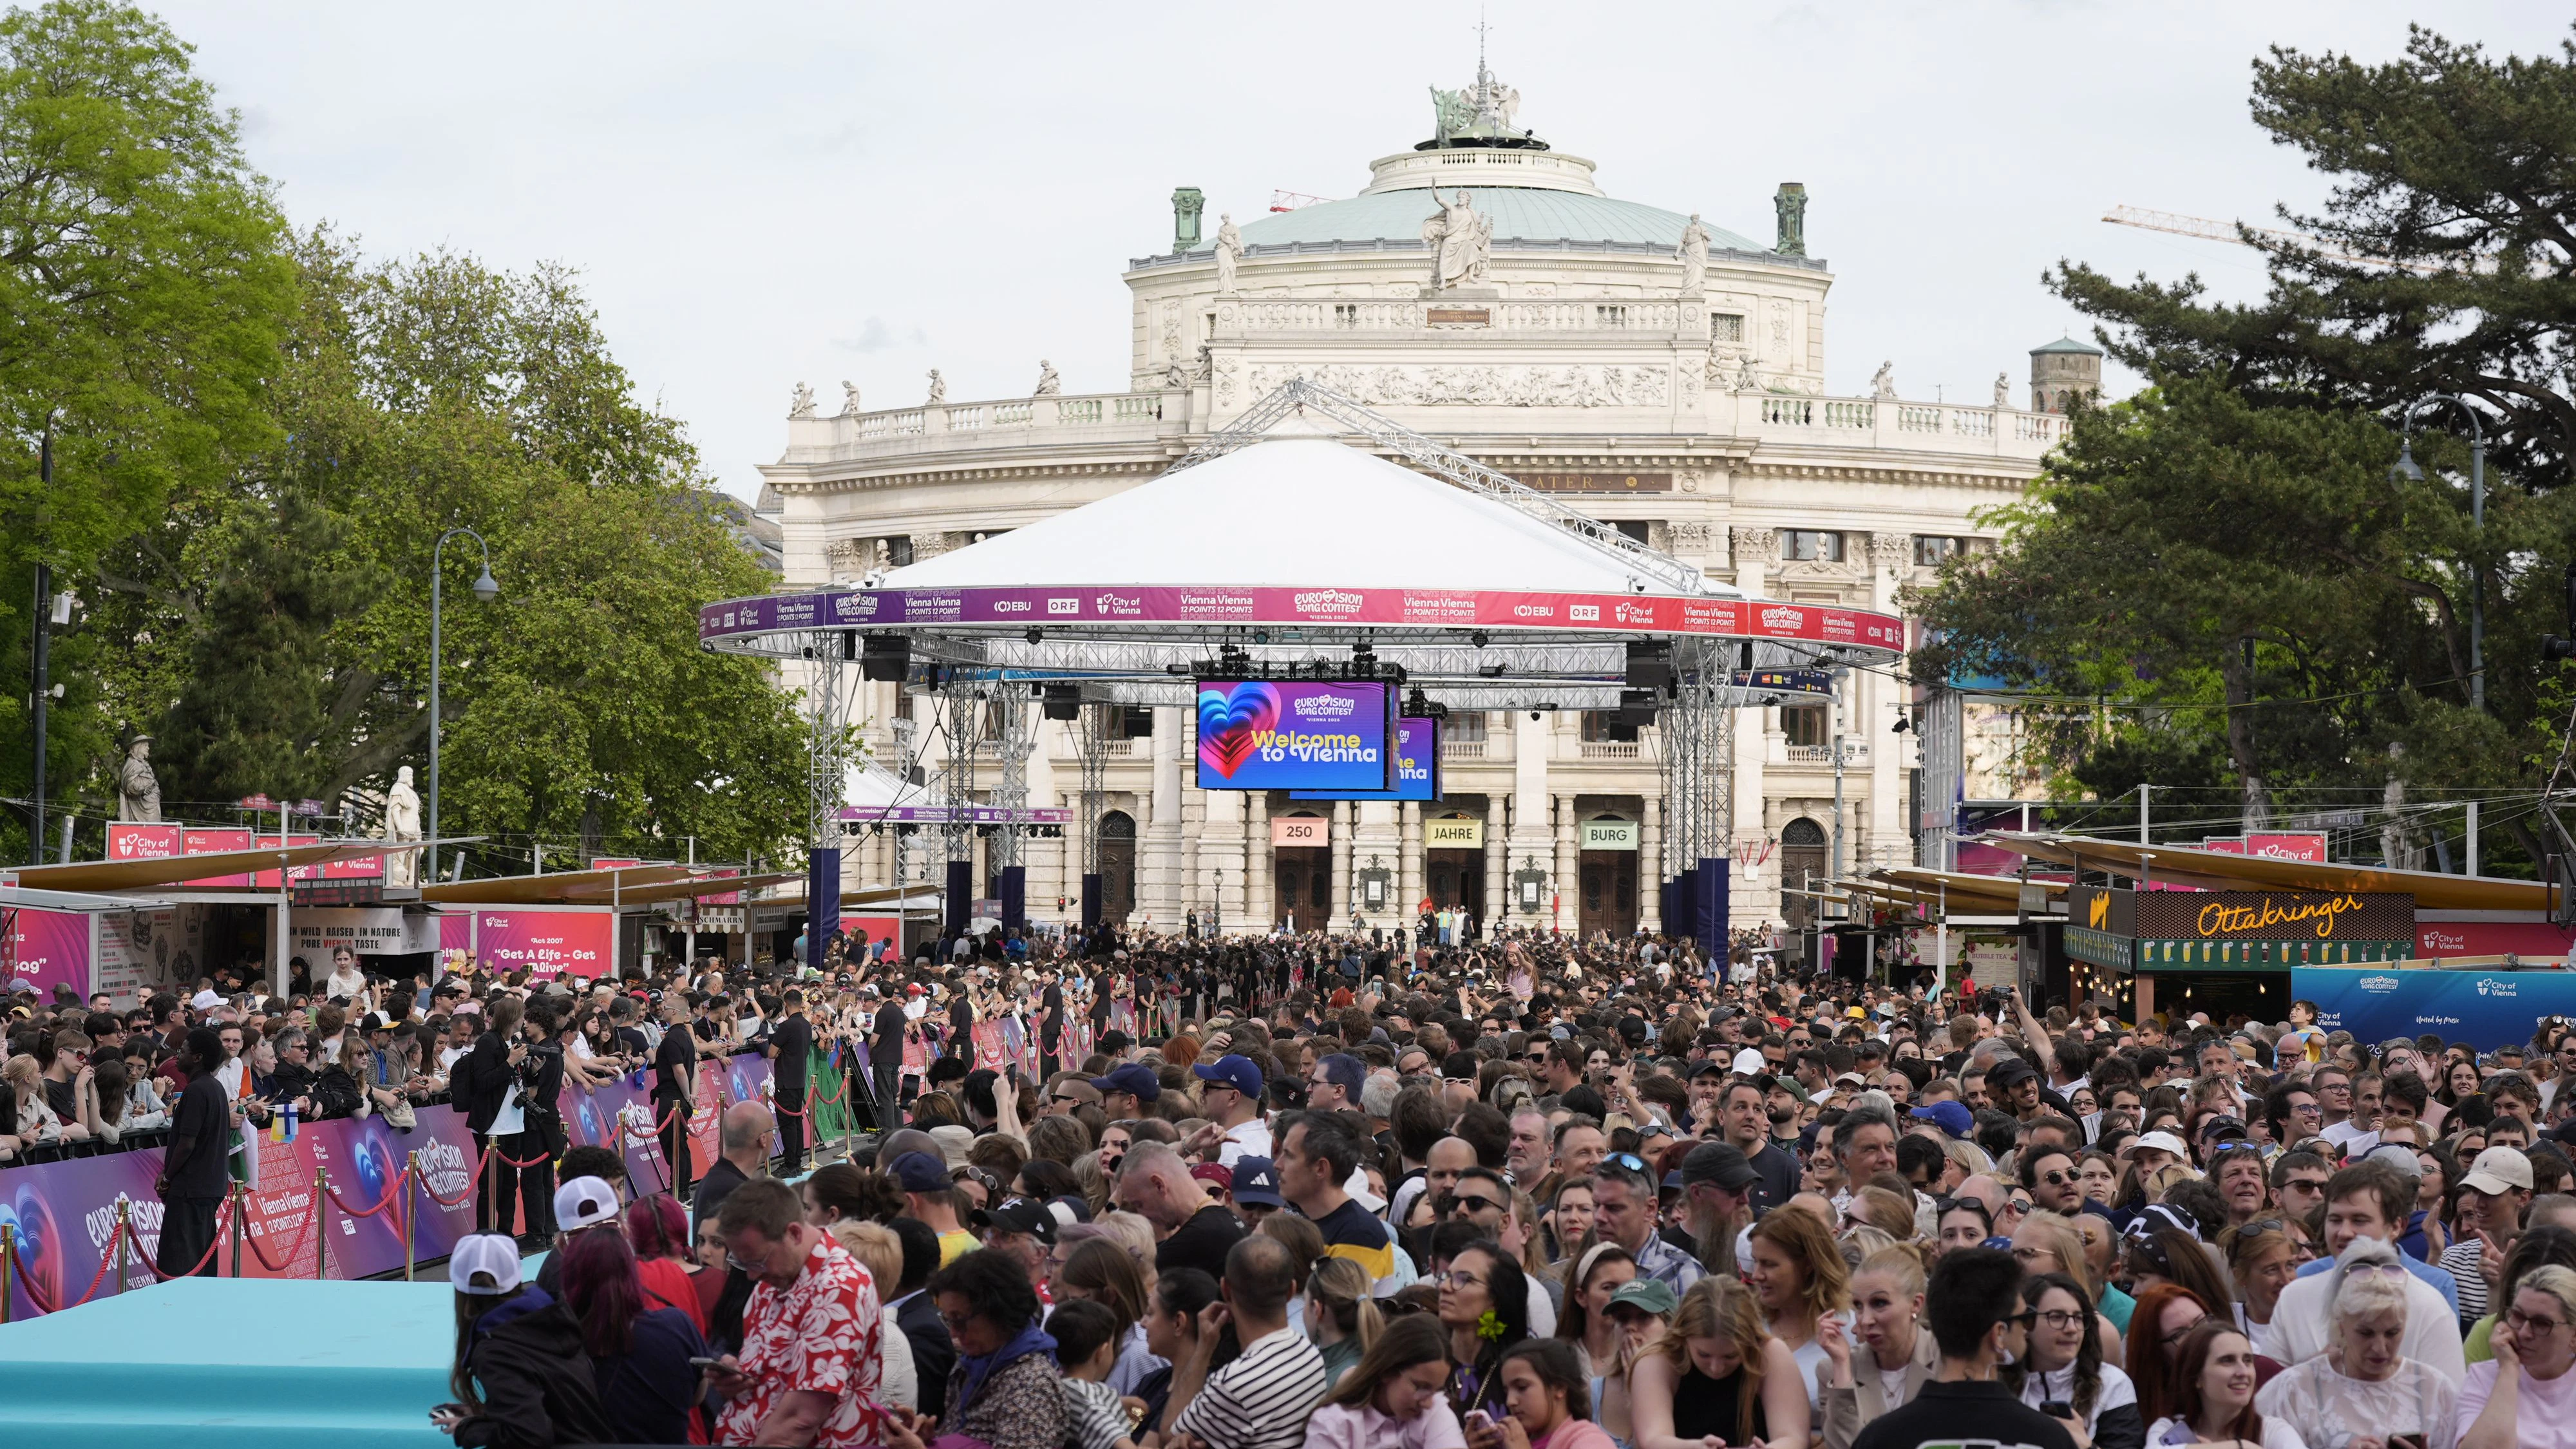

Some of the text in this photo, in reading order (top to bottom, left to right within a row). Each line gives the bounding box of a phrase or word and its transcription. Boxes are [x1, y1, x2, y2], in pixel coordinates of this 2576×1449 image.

[905, 597, 961, 607] Vienna Vienna
[1112, 597, 1141, 607] City of
[1180, 595, 1253, 605] Vienna Vienna
[1404, 598, 1475, 608] Vienna Vienna
[777, 603, 814, 613] Vienna Vienna
[837, 606, 877, 616] SONG CONTEST
[1011, 601, 1031, 611] EBU
[1050, 602, 1076, 611] ORF
[1296, 603, 1362, 613] SONG CONTEST
[1533, 607, 1553, 617] EBU
[1572, 609, 1597, 618] ORF
[1629, 607, 1644, 616] City
[1684, 607, 1735, 618] Vienna Vienna
[1629, 615, 1654, 624] Vienna
[1763, 618, 1803, 630] SONG CONTEST
[1823, 616, 1855, 628] Vienna Vienna
[1296, 707, 1354, 716] SONG CONTEST
[1251, 730, 1361, 748] Welcome
[1261, 745, 1377, 762] to Vienna
[1286, 826, 1313, 838] 250
[1434, 828, 1473, 840] JAHRE
[1590, 829, 1627, 841] BURG
[137, 838, 169, 849] City of
[137, 847, 170, 857] Vienna
[2299, 849, 2313, 860] of
[348, 860, 375, 869] Vienna
[2197, 895, 2363, 937] Ottakringer
[301, 927, 401, 938] WILD RAISED IN NATURE
[2438, 934, 2454, 943] City
[301, 939, 321, 949] PURE
[526, 950, 535, 960] A
[537, 949, 561, 960] Life
[572, 949, 596, 960] Get
[2491, 981, 2506, 991] City
[2317, 1012, 2340, 1021] City of
[2416, 1016, 2434, 1025] United
[2436, 1015, 2443, 1025] by
[257, 1192, 310, 1216] Vienna Vienna
[459, 1200, 471, 1211] 2026
[272, 1215, 292, 1233] POINTS
[343, 1222, 354, 1233] ORF
[128, 1273, 157, 1289] VIENNA
